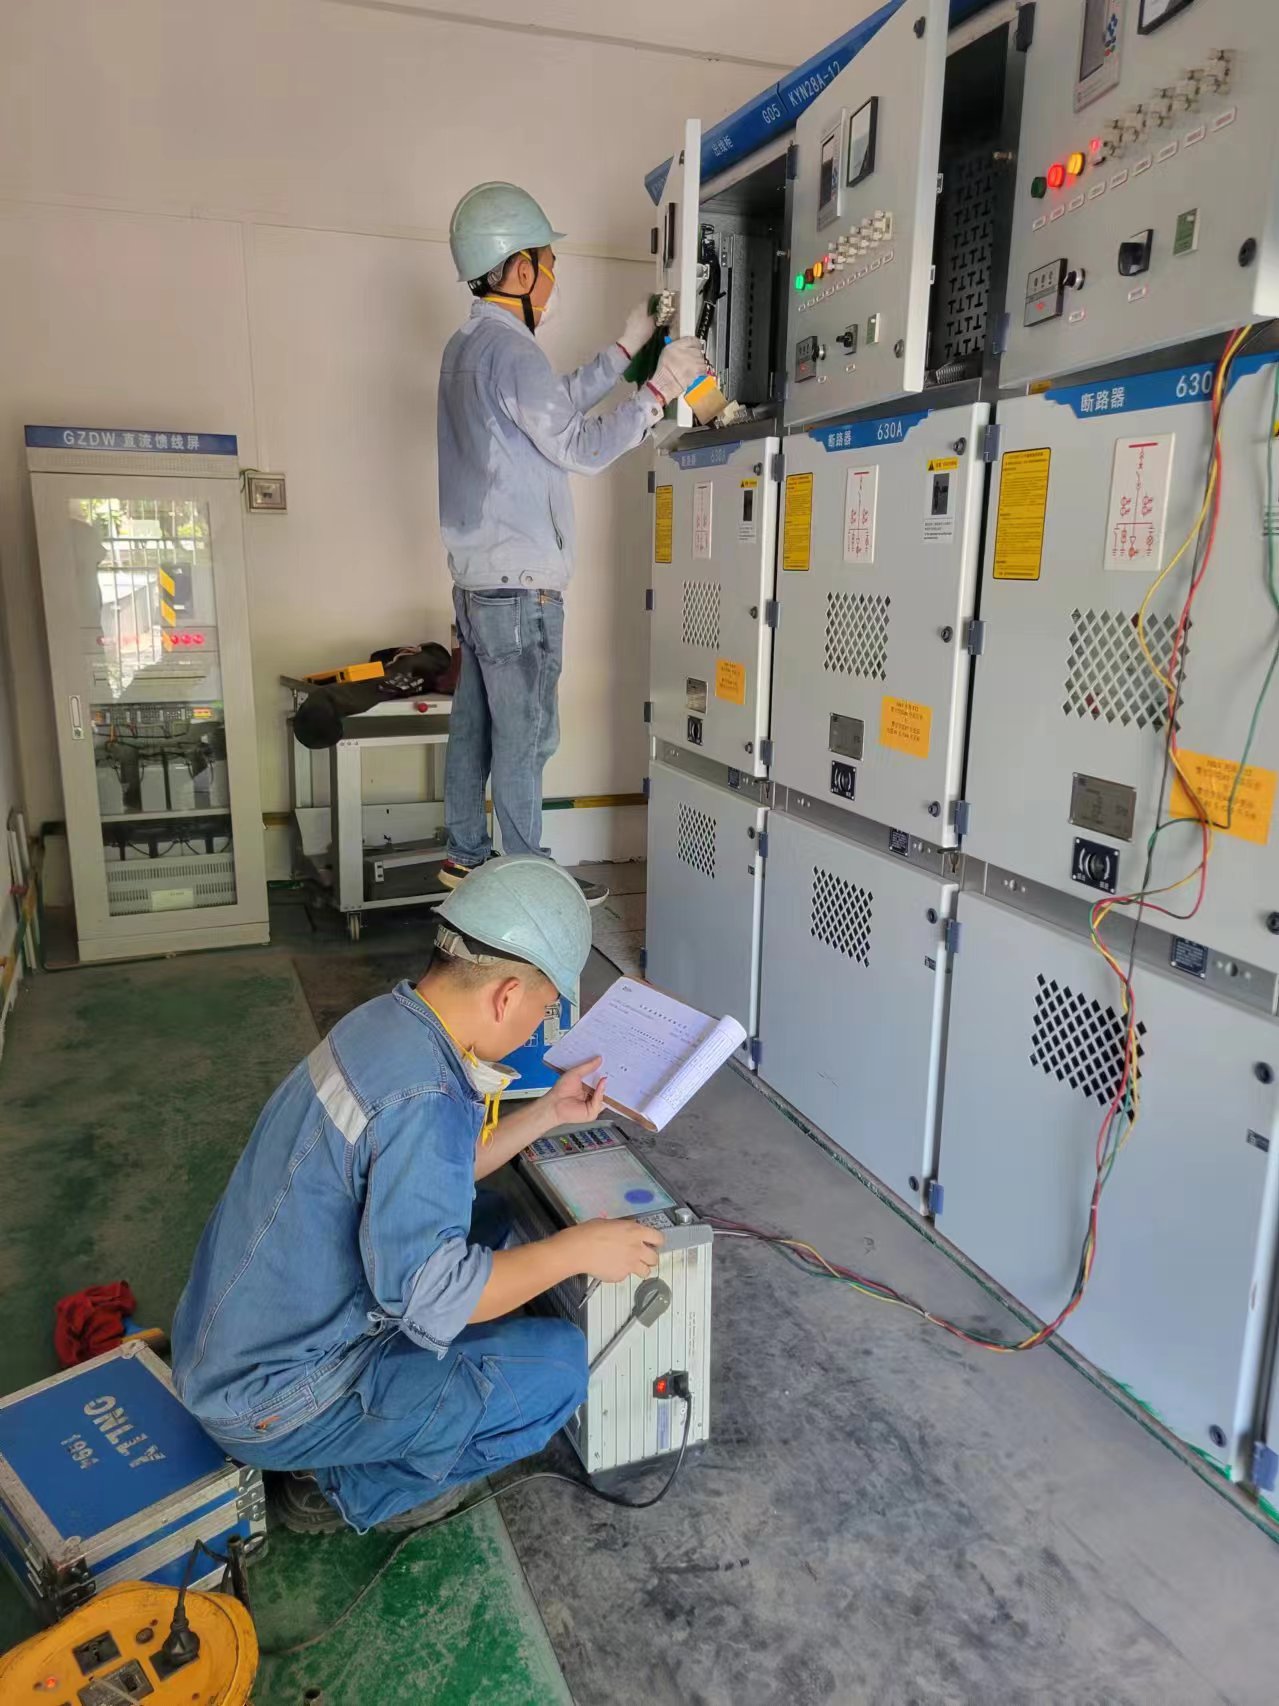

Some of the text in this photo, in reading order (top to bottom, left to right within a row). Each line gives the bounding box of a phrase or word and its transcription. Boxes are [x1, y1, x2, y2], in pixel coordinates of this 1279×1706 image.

[1176, 370, 1213, 398] 630
[1080, 386, 1126, 413] 断路器
[63, 430, 116, 446] GZDW
[828, 430, 852, 448] 断路器
[877, 420, 903, 441] 630A
[122, 432, 200, 450] 直流馈线屏
